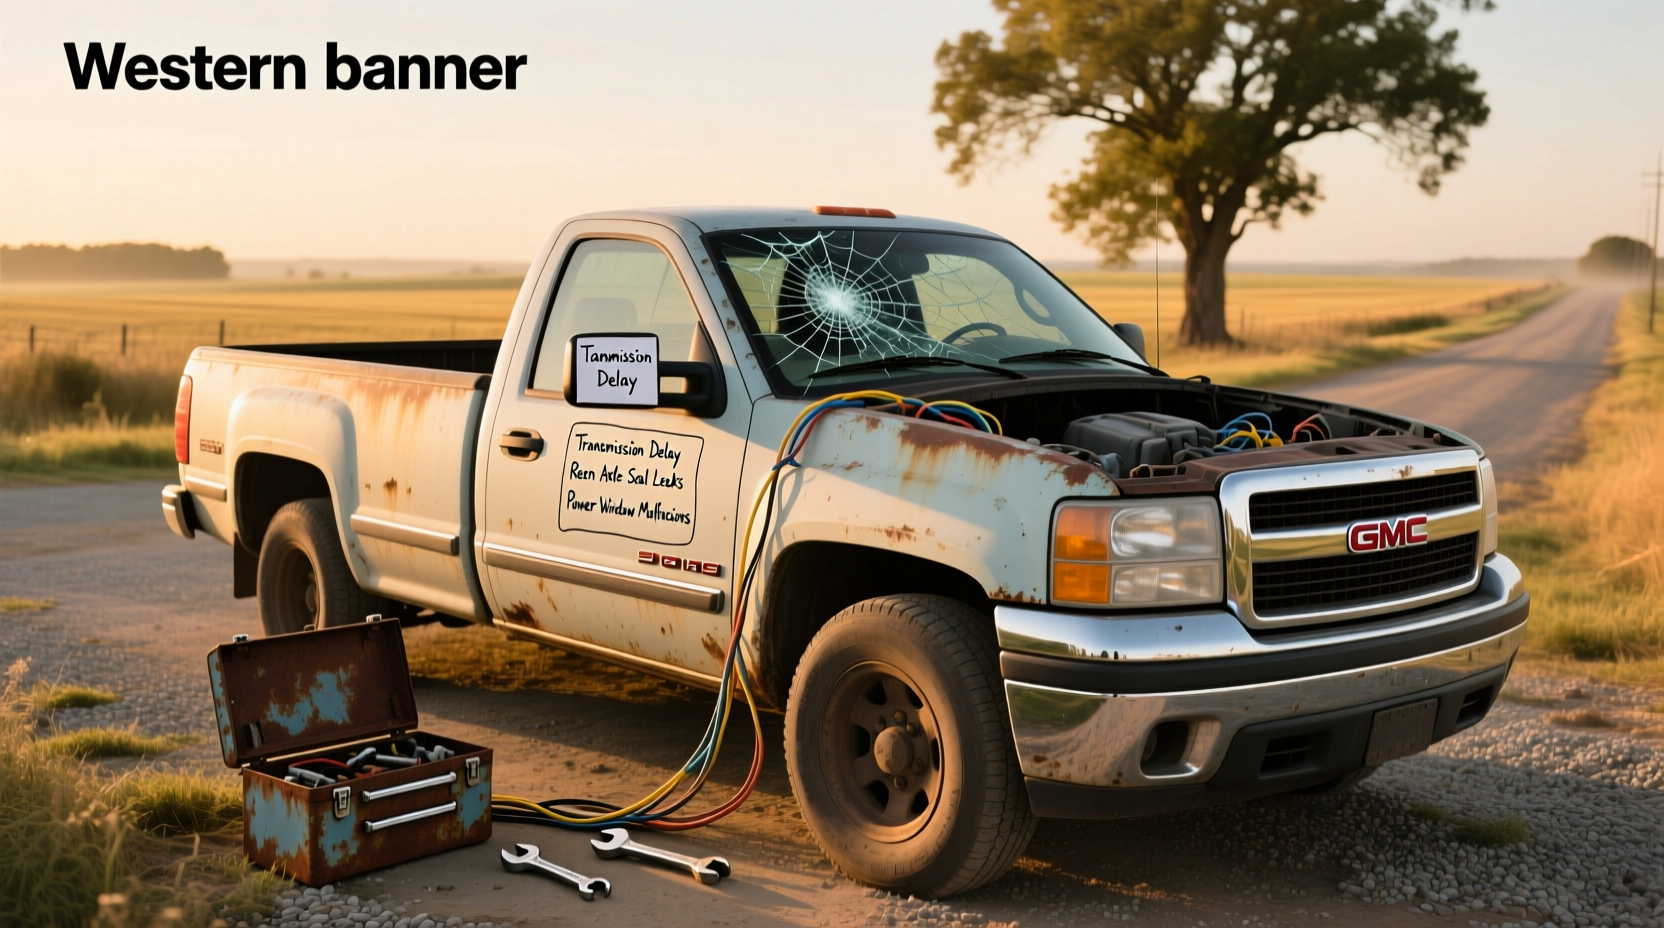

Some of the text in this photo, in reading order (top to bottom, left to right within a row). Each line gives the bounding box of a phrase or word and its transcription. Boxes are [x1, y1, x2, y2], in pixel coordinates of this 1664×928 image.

[597, 369, 638, 396] Delay
[649, 439, 681, 469] Delay
[1348, 514, 1428, 554] GMC
